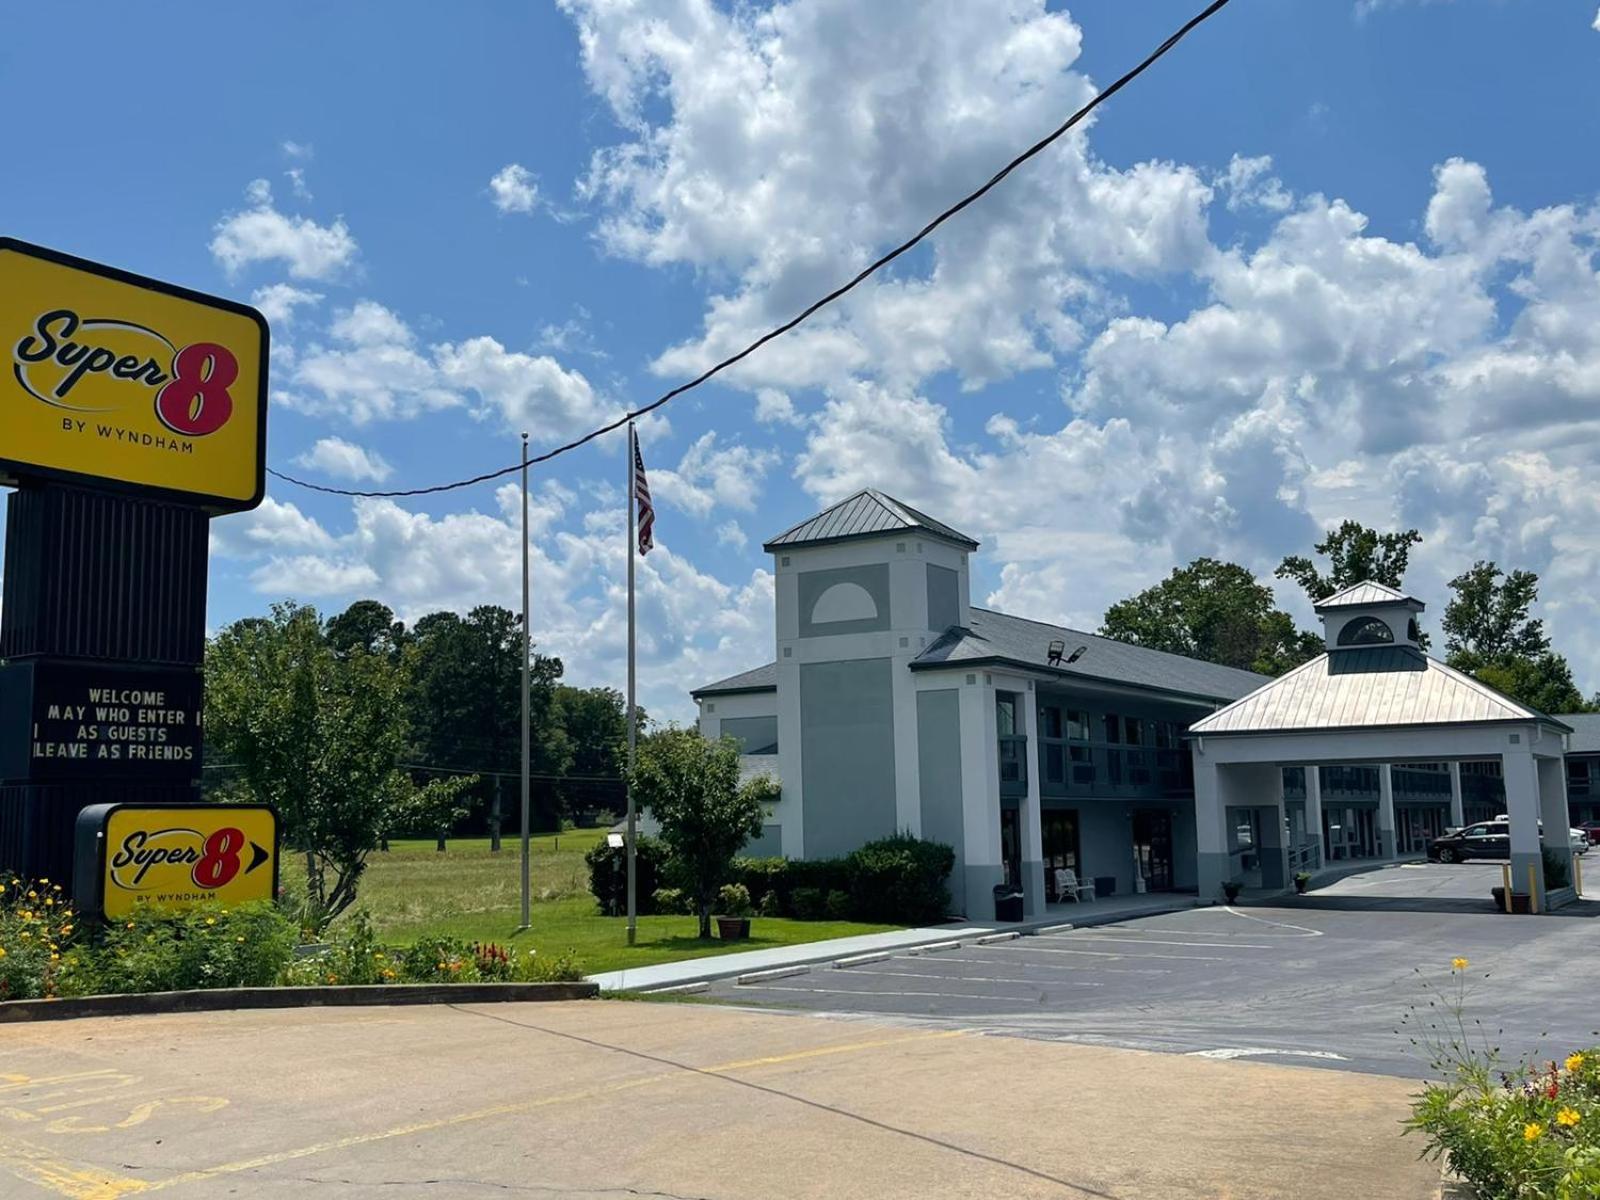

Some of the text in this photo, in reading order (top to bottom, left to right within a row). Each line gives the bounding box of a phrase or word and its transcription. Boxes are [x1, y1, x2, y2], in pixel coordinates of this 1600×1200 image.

[15, 308, 239, 436] Super 8
[62, 418, 193, 453] BY WYNDHAM
[89, 688, 164, 706] WELCOME
[48, 705, 85, 720] MAY
[96, 707, 129, 722] WHO
[138, 709, 184, 724] ENTER
[77, 725, 167, 741] AS GUESTS
[98, 744, 120, 759] AS
[111, 827, 245, 889] Super 8
[157, 893, 216, 902] WYNDHAM
